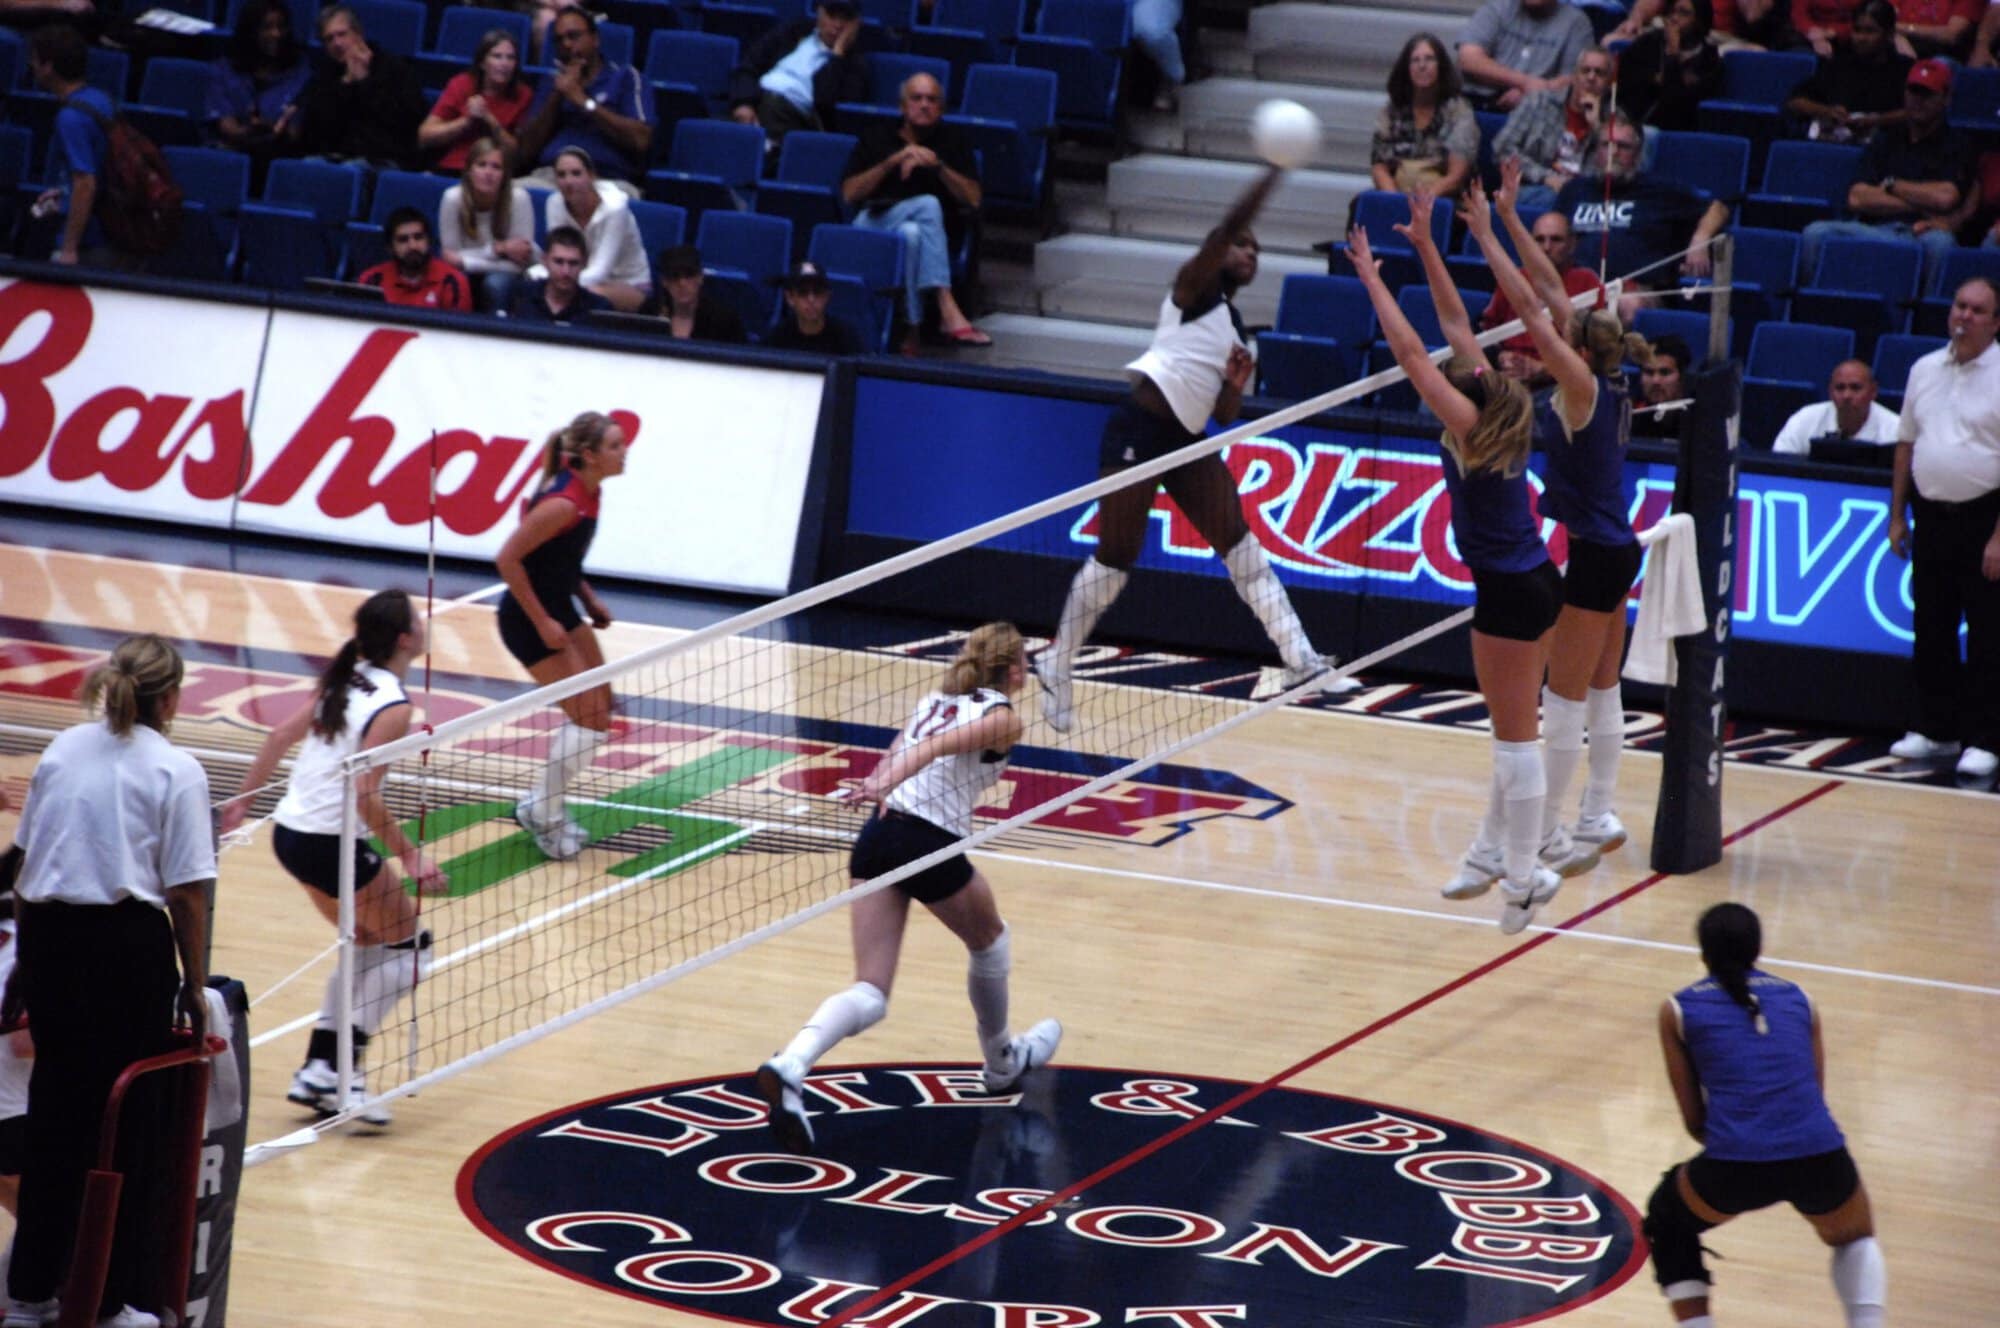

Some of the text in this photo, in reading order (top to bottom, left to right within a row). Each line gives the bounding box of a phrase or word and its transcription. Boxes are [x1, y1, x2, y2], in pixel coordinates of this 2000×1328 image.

[1573, 201, 1635, 225] UMC
[538, 1069, 1613, 1293] LUTE & BOBBI
[698, 1152, 1407, 1278] OLSON
